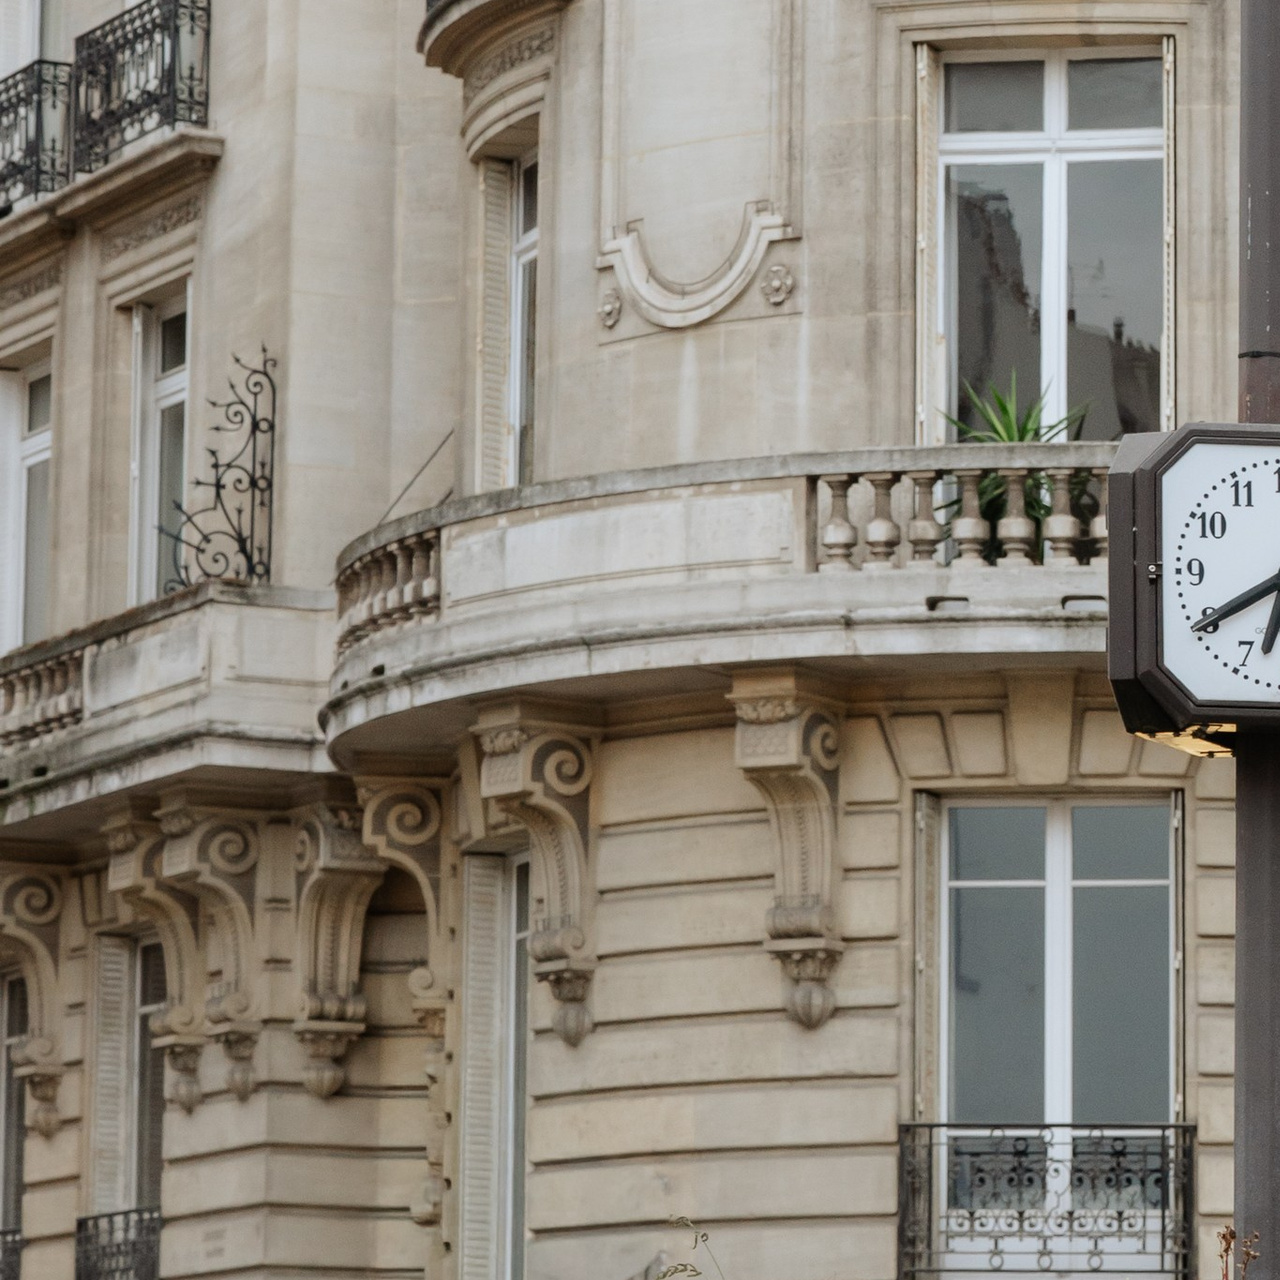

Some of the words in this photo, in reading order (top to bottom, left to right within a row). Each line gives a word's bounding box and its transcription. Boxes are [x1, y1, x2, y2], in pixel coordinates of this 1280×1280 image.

[1230, 480, 1254, 507] 11
[1198, 511, 1227, 539] 10
[1186, 558, 1205, 586] 9
[1238, 640, 1255, 667] 7
